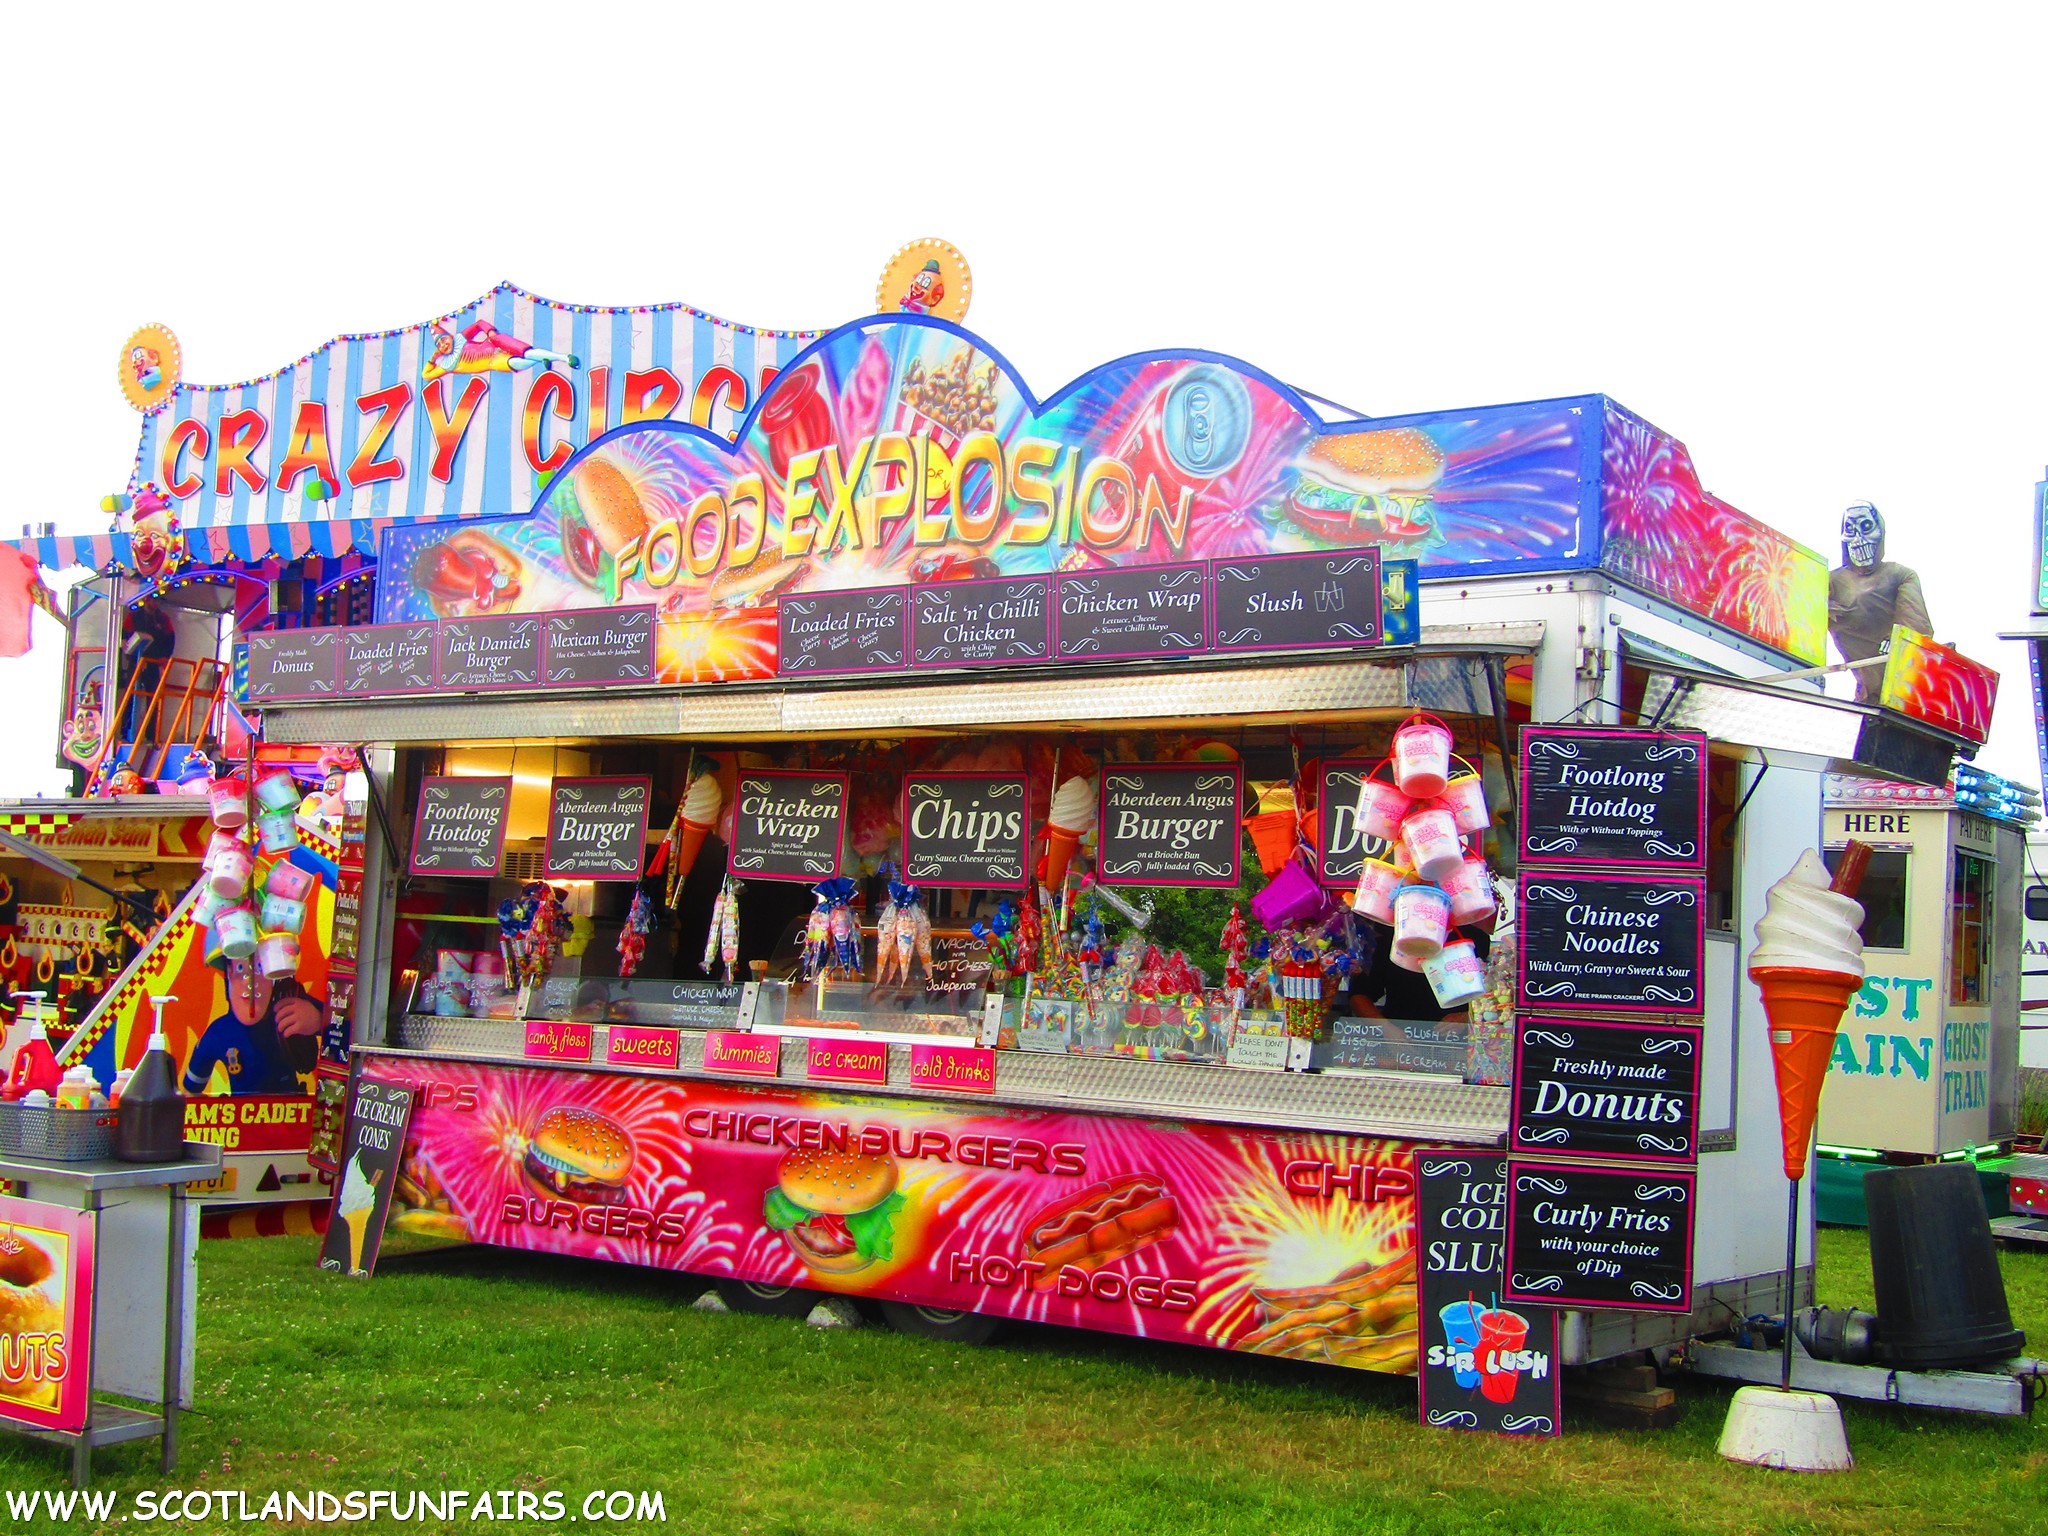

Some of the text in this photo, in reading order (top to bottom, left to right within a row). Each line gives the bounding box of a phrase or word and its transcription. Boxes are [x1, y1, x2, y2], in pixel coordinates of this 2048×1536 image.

[160, 364, 762, 500] CRAZY CIRC
[612, 429, 1194, 601] FOOD EXPLOSION
[921, 605, 957, 625] Salt
[988, 598, 1040, 620] Chilli
[1062, 589, 1201, 614] Chicken Wrap
[1246, 590, 1304, 614] Slush
[789, 610, 896, 634] Loaded Fries
[943, 621, 1016, 643] Chicken
[1102, 623, 1169, 634] Sweet Chilli Mayo
[448, 633, 531, 656] Jack Daniels
[551, 630, 648, 649] Mexican Burger
[800, 634, 820, 647] Cheese
[802, 640, 821, 652] Curry
[828, 631, 848, 646] Cheese
[831, 637, 850, 651] Bacon
[857, 629, 877, 644] Cheese
[859, 636, 879, 649] Gravy
[349, 642, 428, 661] Loaded Fries
[961, 643, 997, 654] with Chips
[972, 649, 994, 659] Curry
[272, 659, 314, 674] Donuts
[466, 653, 512, 671] Burger
[1558, 764, 1665, 793] Footlong
[555, 801, 644, 816] Aberdeen Angus
[741, 796, 839, 818] Chicken
[1107, 792, 1234, 811] Aberdeen Angus
[1566, 795, 1657, 824] Hotdog
[423, 802, 501, 825] Footlong
[1844, 814, 1910, 833] HERE
[108, 824, 152, 847] Sam
[426, 824, 492, 847] Hotdog
[558, 816, 636, 849] Burger
[756, 817, 820, 844] Wrap
[911, 798, 1022, 853] Chips
[1114, 810, 1224, 849] Burger
[1559, 825, 1580, 833] With
[1591, 826, 1625, 835] Without
[1626, 827, 1663, 838] Toppings
[1960, 815, 1972, 838] PAY
[578, 859, 610, 868] fully loaded
[914, 853, 934, 864] Curry
[934, 854, 958, 863] Sauce,
[959, 854, 985, 863] Cheese
[993, 855, 1016, 865] Gravy
[1154, 850, 1182, 859] Brioche
[1184, 851, 1200, 859] Bun
[1145, 861, 1190, 872] fully loaded
[1565, 905, 1660, 928] Chinese
[1562, 931, 1660, 955] Noodles
[1528, 961, 1690, 977] With Curry, Gravy or Sweet & Sour
[672, 985, 739, 999] CHICKEN WRAP
[1850, 976, 1933, 1021] ST
[1333, 1021, 1384, 1037] DONUTS
[1404, 1026, 1439, 1041] SLUSH
[527, 1029, 587, 1054] candy floss
[612, 1037, 673, 1057] sweets
[1237, 1047, 1262, 1057] TOUCH
[1943, 1021, 1989, 1062] GHOST
[712, 1043, 772, 1065] dummies
[810, 1048, 883, 1072] ice cream
[1396, 1053, 1448, 1069] ICE CREAM
[1828, 1033, 1933, 1082] AIN
[913, 1055, 991, 1082] cold drinks
[1552, 1057, 1667, 1080] Freshly made
[392, 1078, 479, 1112] HIPS
[1531, 1080, 1684, 1123] Donuts
[1944, 1070, 1987, 1114] TRAIN
[184, 1102, 312, 1125] AM'S CADET
[352, 1097, 405, 1129] ICE CREAM
[184, 1126, 240, 1148] NING
[359, 1125, 391, 1151] CONES
[682, 1108, 1087, 1177] CHICKEN BURGERS
[1283, 1160, 1415, 1202] CHIP
[1458, 1182, 1507, 1205] ICE
[501, 1192, 688, 1244] BURGERS
[1440, 1207, 1504, 1230] COL
[1533, 1201, 1671, 1233] Curly Fries
[1427, 1240, 1504, 1274] SLU
[1540, 1237, 1660, 1257] with your choice
[1576, 1259, 1622, 1278] of Dip
[949, 1251, 1198, 1313] HOT DOGS
[1486, 1349, 1549, 1379] LUSH
